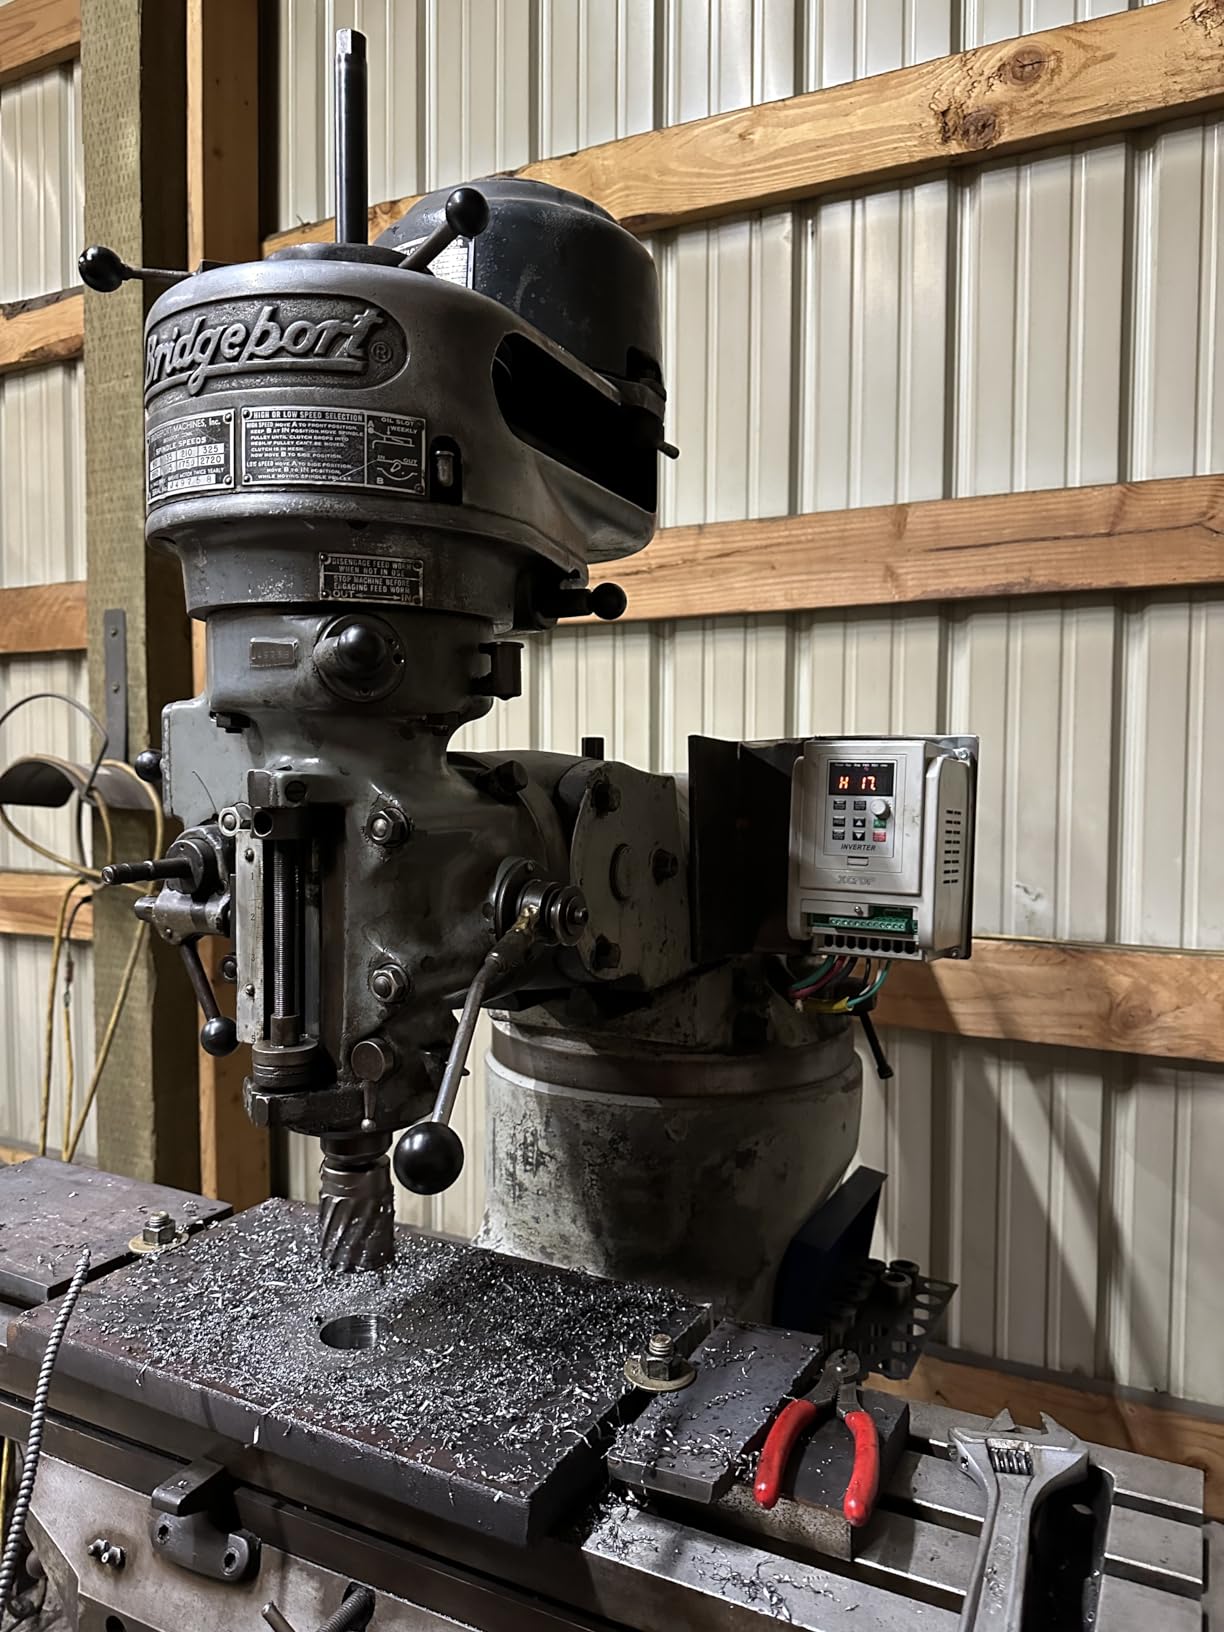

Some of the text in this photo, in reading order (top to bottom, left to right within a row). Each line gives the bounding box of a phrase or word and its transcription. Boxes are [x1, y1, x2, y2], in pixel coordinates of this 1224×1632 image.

[146, 305, 384, 396] Bridgeport
[253, 411, 270, 419] HIGH
[300, 411, 322, 419] SPEED
[325, 412, 363, 421] SELECTION
[209, 418, 221, 426] Inc.
[367, 420, 375, 428] A
[396, 419, 414, 427] SLOT
[390, 425, 418, 434] WEEKLY
[178, 437, 207, 447] SPEEDS
[181, 448, 193, 458] 210
[202, 445, 219, 454] 325
[200, 455, 222, 465] 2720
[376, 477, 385, 485] B
[332, 557, 371, 567] DISENGAGE
[373, 560, 390, 569] FEED
[339, 565, 360, 573] WHEN
[363, 567, 378, 575] NOT
[391, 569, 405, 577] USE
[333, 575, 410, 587] STOP MACHINE BEFORE
[333, 582, 411, 594] ENGAGING FEED WORM
[332, 589, 412, 602] OUT IN
[838, 775, 849, 790] H
[840, 843, 877, 851] INVERTER
[250, 912, 256, 921] 2
